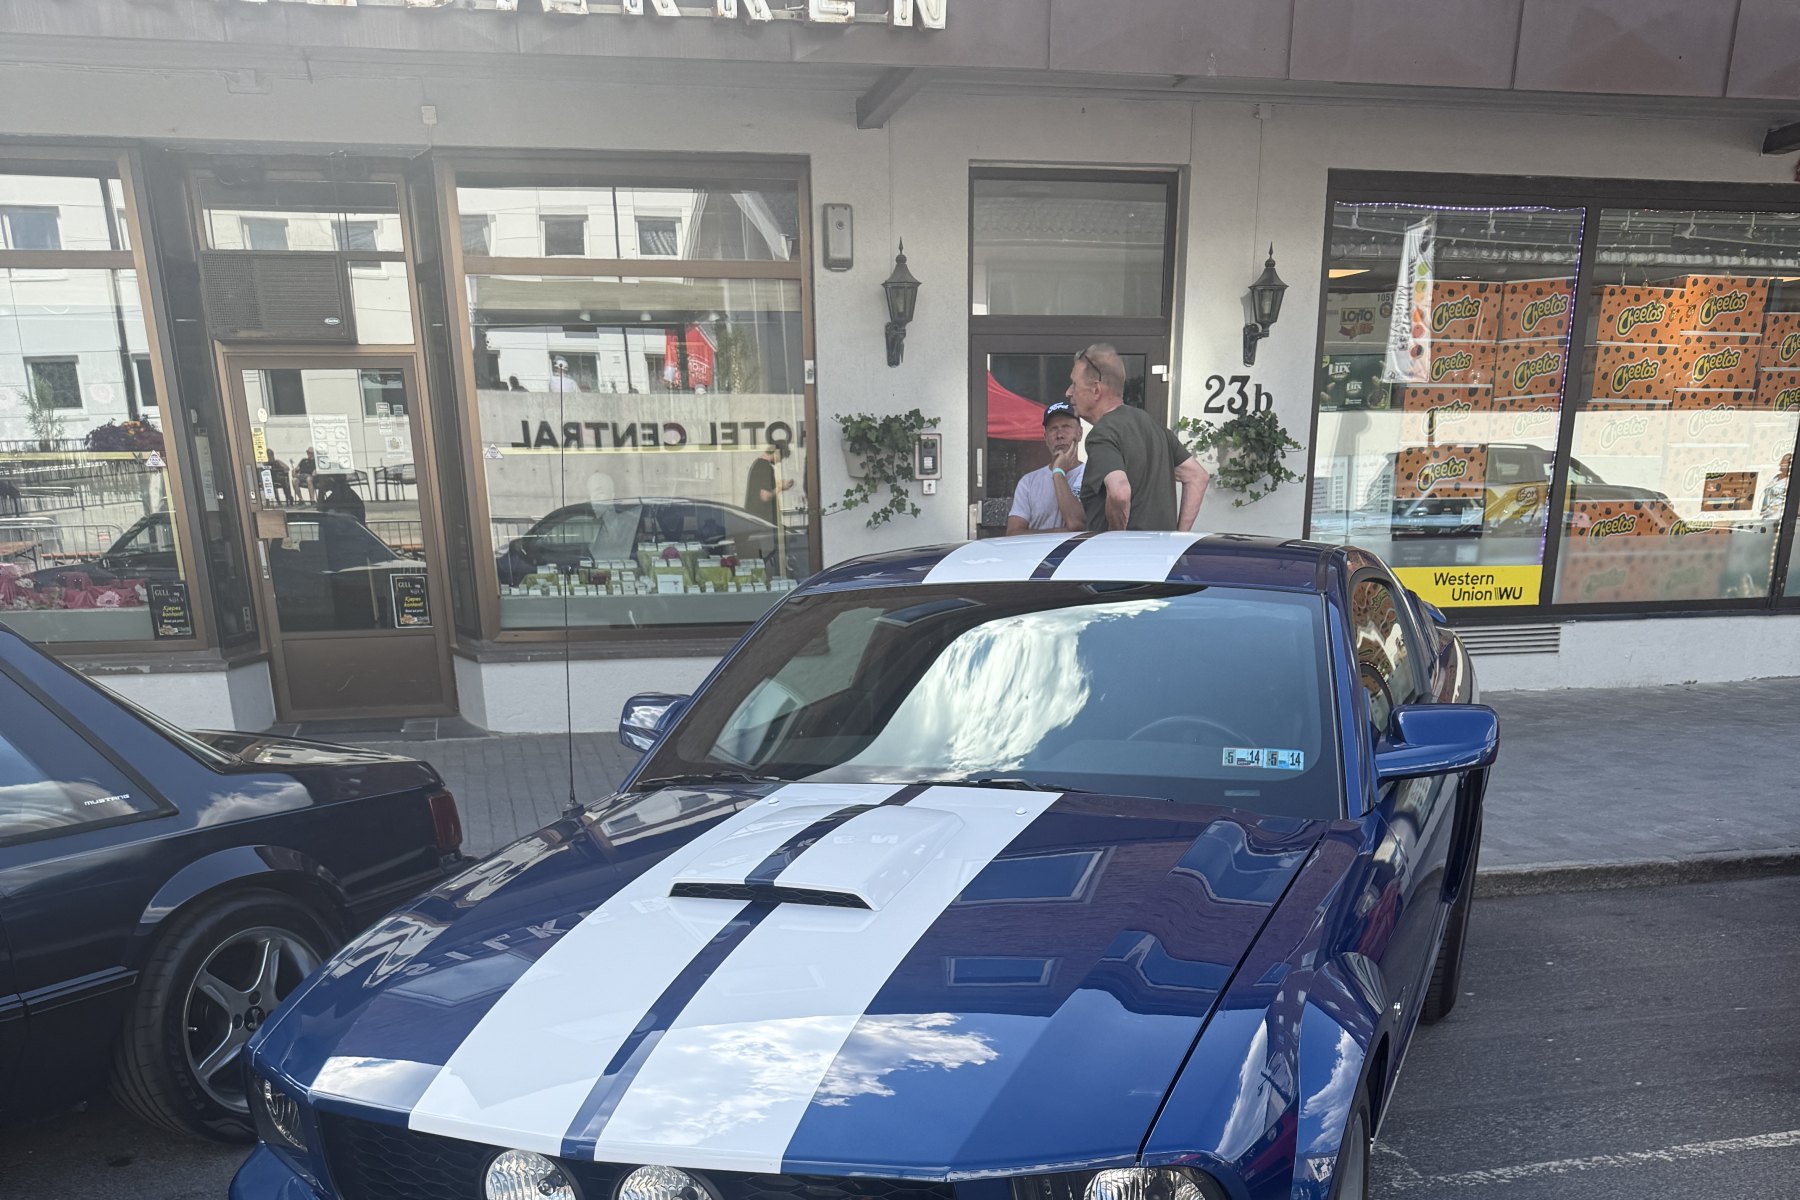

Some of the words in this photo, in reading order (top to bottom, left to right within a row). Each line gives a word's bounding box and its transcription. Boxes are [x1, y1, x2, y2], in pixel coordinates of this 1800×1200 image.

[1432, 296, 1481, 332] Cheetos
[1522, 294, 1569, 331] Cheetos
[1617, 301, 1665, 335] Cheetos
[1699, 290, 1748, 325] Cheetos
[1431, 352, 1472, 381] Cheetos
[1514, 352, 1561, 389] Cheetos
[1612, 358, 1659, 392] Cheetos
[1693, 347, 1740, 382] Cheetos
[1204, 374, 1273, 414] 23b
[1422, 400, 1471, 436] Cheetos
[1513, 406, 1553, 436] Cheetos
[1601, 415, 1648, 448] Cheetos
[1689, 404, 1734, 436] Cheetos
[1418, 456, 1467, 491] Cheetos
[1590, 513, 1637, 545] Cheetos
[1434, 573, 1494, 586] Western
[1452, 587, 1492, 601] Union
[1498, 587, 1523, 600] WU
[1249, 750, 1260, 764] 14
[1290, 752, 1301, 766] 14
[84, 794, 130, 806] MUSTANG
